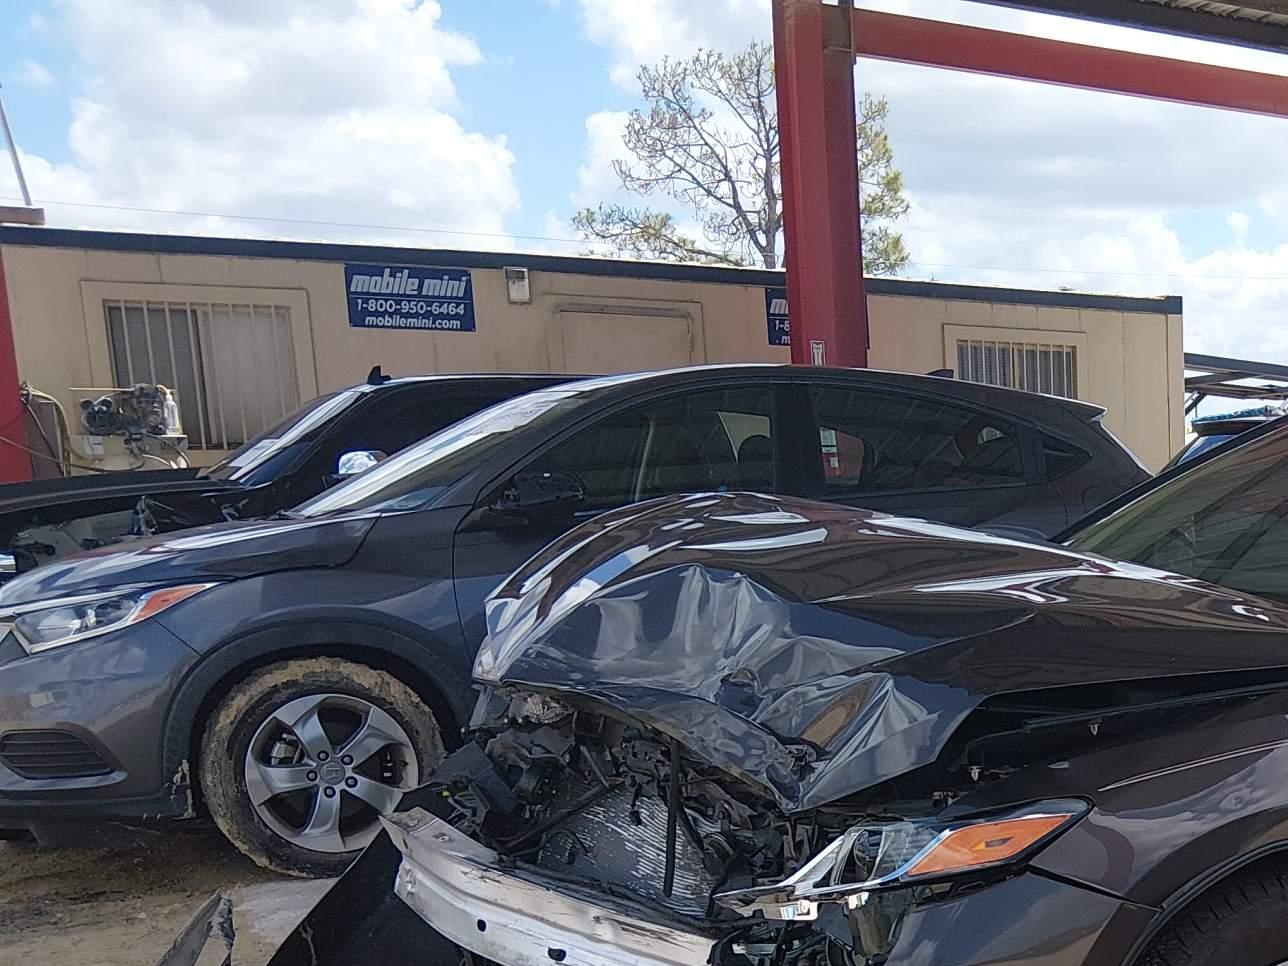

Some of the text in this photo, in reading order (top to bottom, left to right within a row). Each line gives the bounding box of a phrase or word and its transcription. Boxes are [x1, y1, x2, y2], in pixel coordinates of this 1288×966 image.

[350, 268, 467, 297] mobile mini
[356, 299, 465, 315] 1-800-950-6464
[364, 314, 461, 329] mobilemini.com
